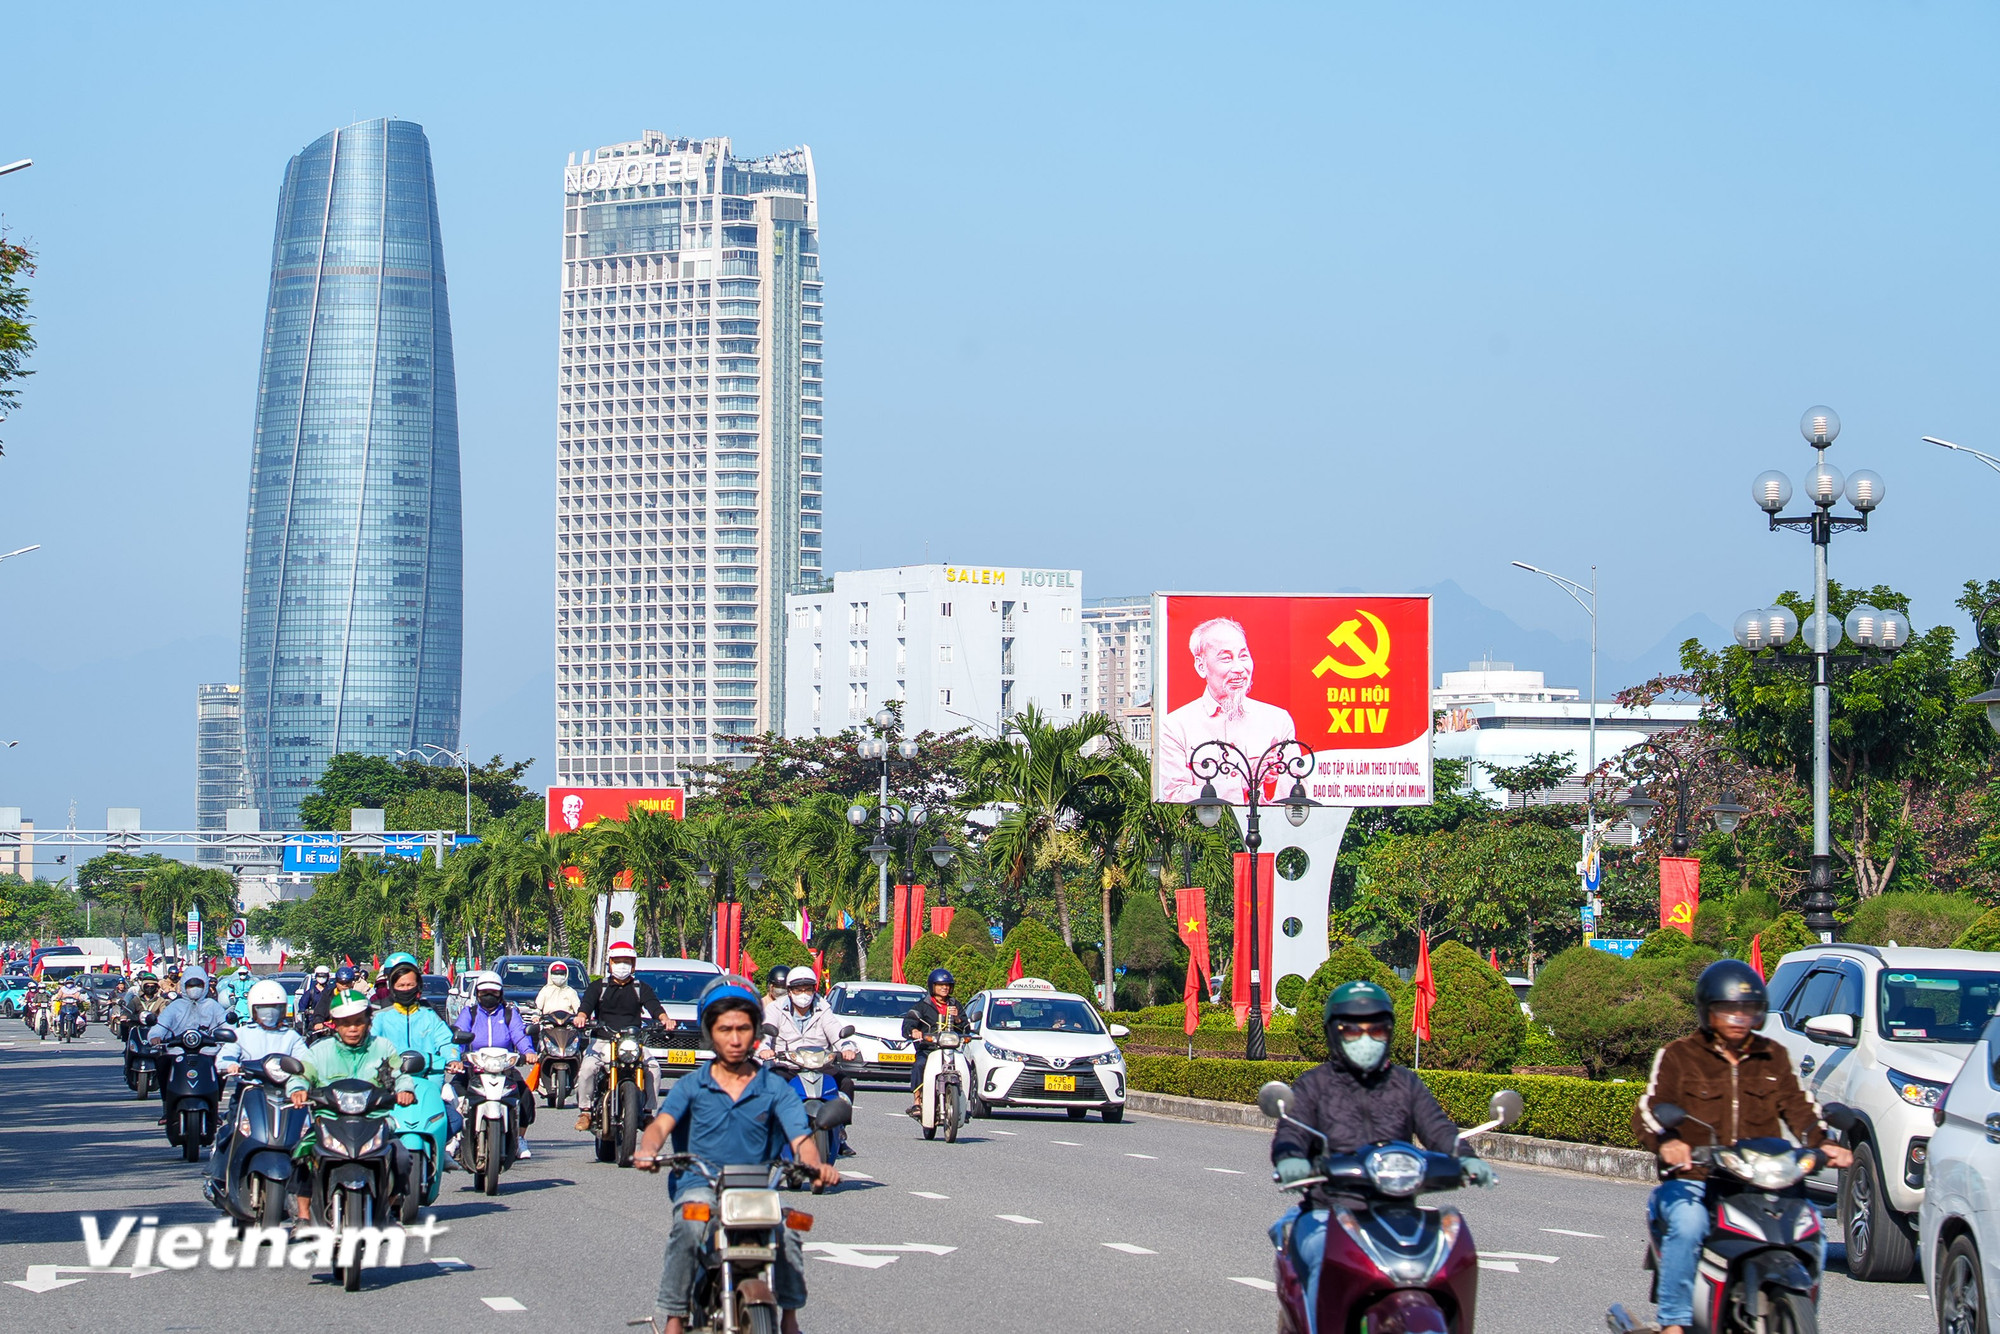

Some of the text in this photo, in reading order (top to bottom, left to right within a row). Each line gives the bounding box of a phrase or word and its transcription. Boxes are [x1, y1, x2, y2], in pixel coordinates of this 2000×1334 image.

[564, 156, 698, 192] NOVOTEL
[946, 568, 1075, 587] SALEM HOTEL
[1327, 684, 1390, 706] ĐẠI HỘI
[1327, 708, 1390, 734] XIV
[1318, 757, 1421, 778] HỌC TẬP VÀ LÀM THEO TƯ TƯỞNG,
[1313, 784, 1326, 801] ĐẠO
[1327, 782, 1342, 798] ĐỨC,
[1344, 784, 1366, 797] PHONG
[1367, 782, 1384, 797] CÁCH
[1396, 782, 1407, 797] CHÍ
[1408, 784, 1426, 797] MINH
[660, 796, 675, 811] KẾT
[305, 851, 337, 863] RẼ TRÁI
